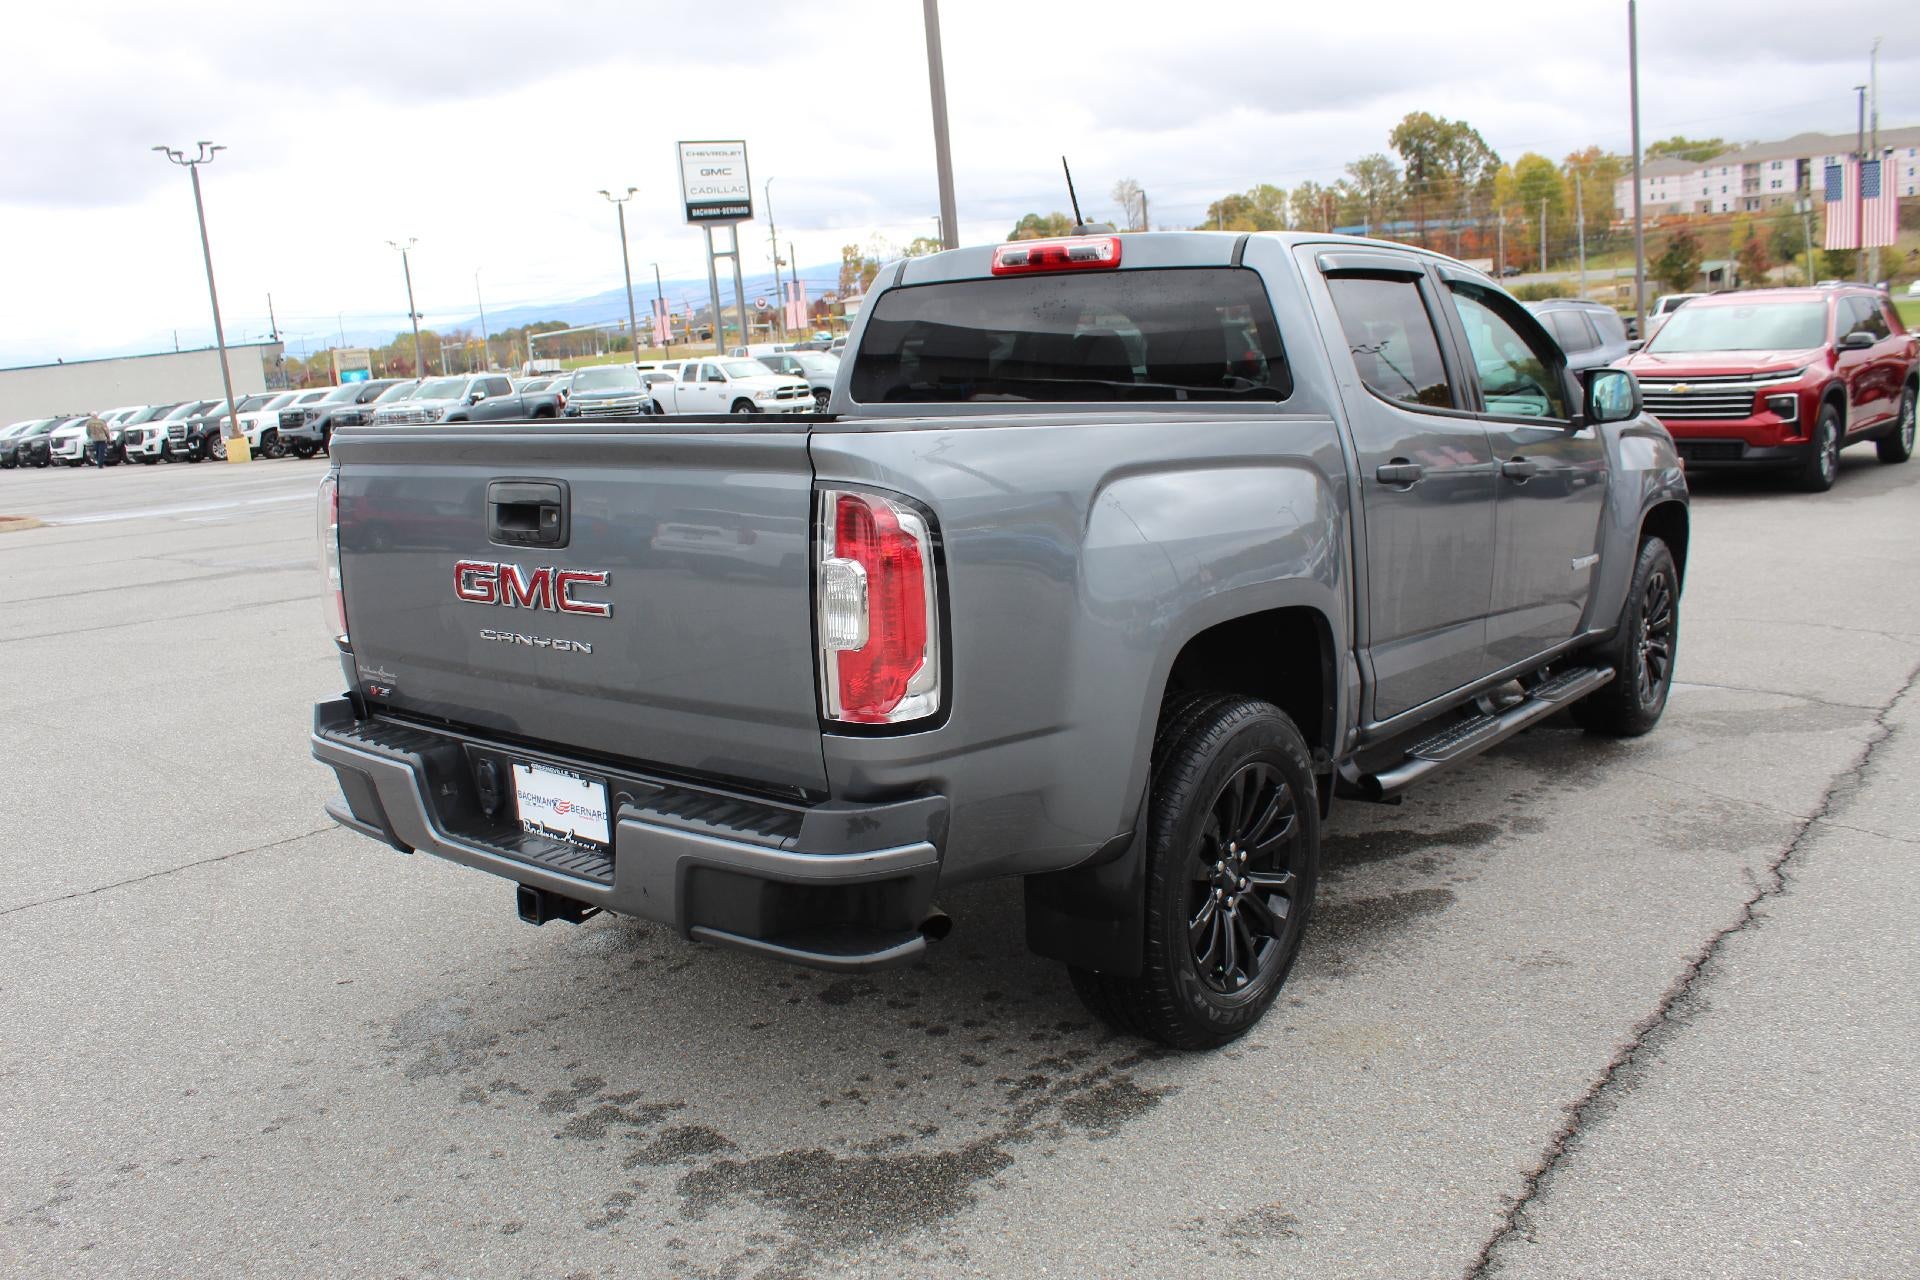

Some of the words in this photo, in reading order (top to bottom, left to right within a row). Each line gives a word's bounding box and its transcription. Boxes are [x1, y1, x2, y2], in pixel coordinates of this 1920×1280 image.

[700, 167, 732, 176] GMC
[690, 186, 745, 195] CADILLAC
[454, 559, 613, 618] GMC
[480, 629, 592, 654] CANYON
[518, 790, 554, 807] BACHMAN
